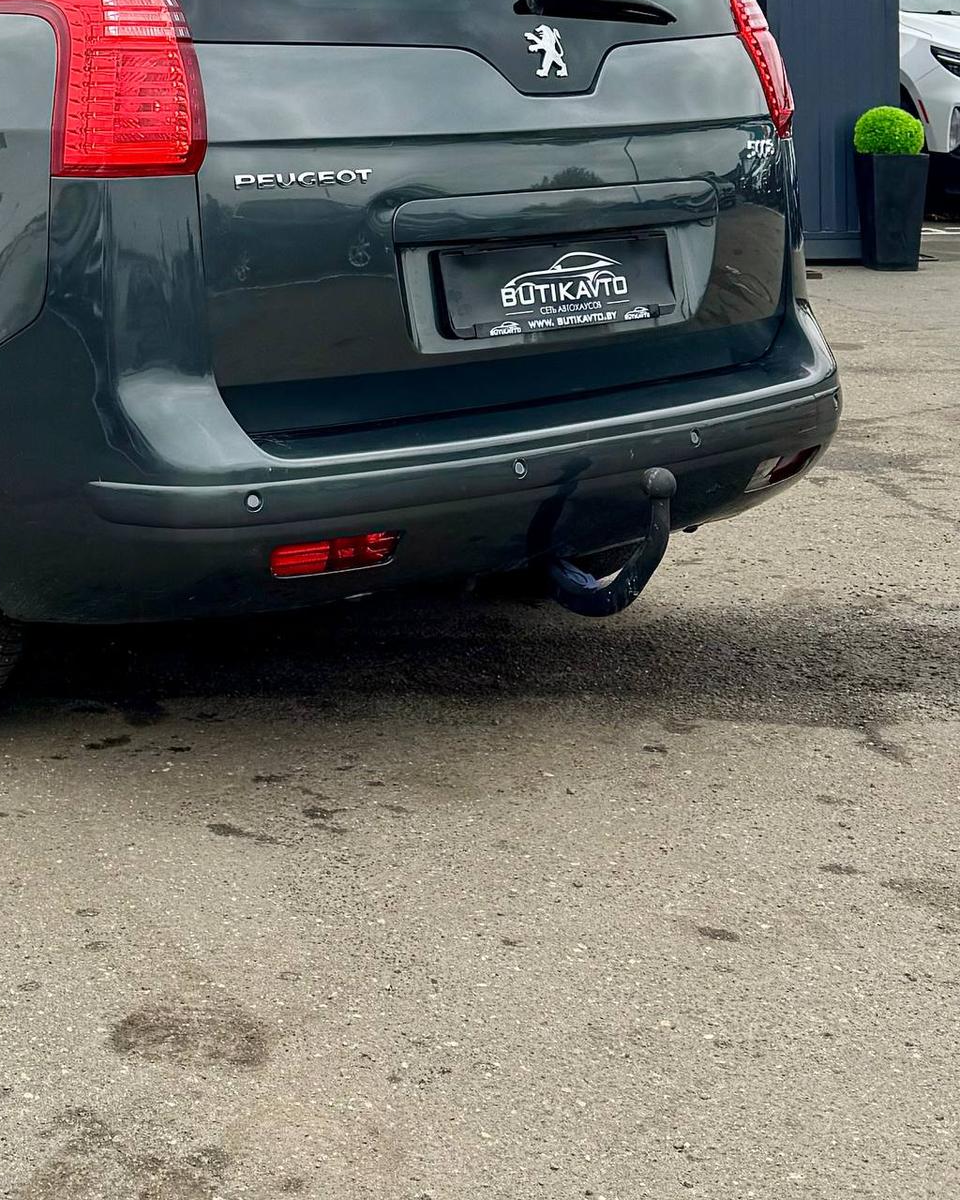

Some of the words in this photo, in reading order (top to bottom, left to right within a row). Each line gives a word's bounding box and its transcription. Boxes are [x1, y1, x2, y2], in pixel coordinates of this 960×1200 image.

[234, 168, 373, 191] PEUGEOT
[501, 276, 628, 307] BUTIKAVTO
[528, 319, 555, 329] WWW.
[556, 310, 618, 326] BUTIKAVTO.BY
